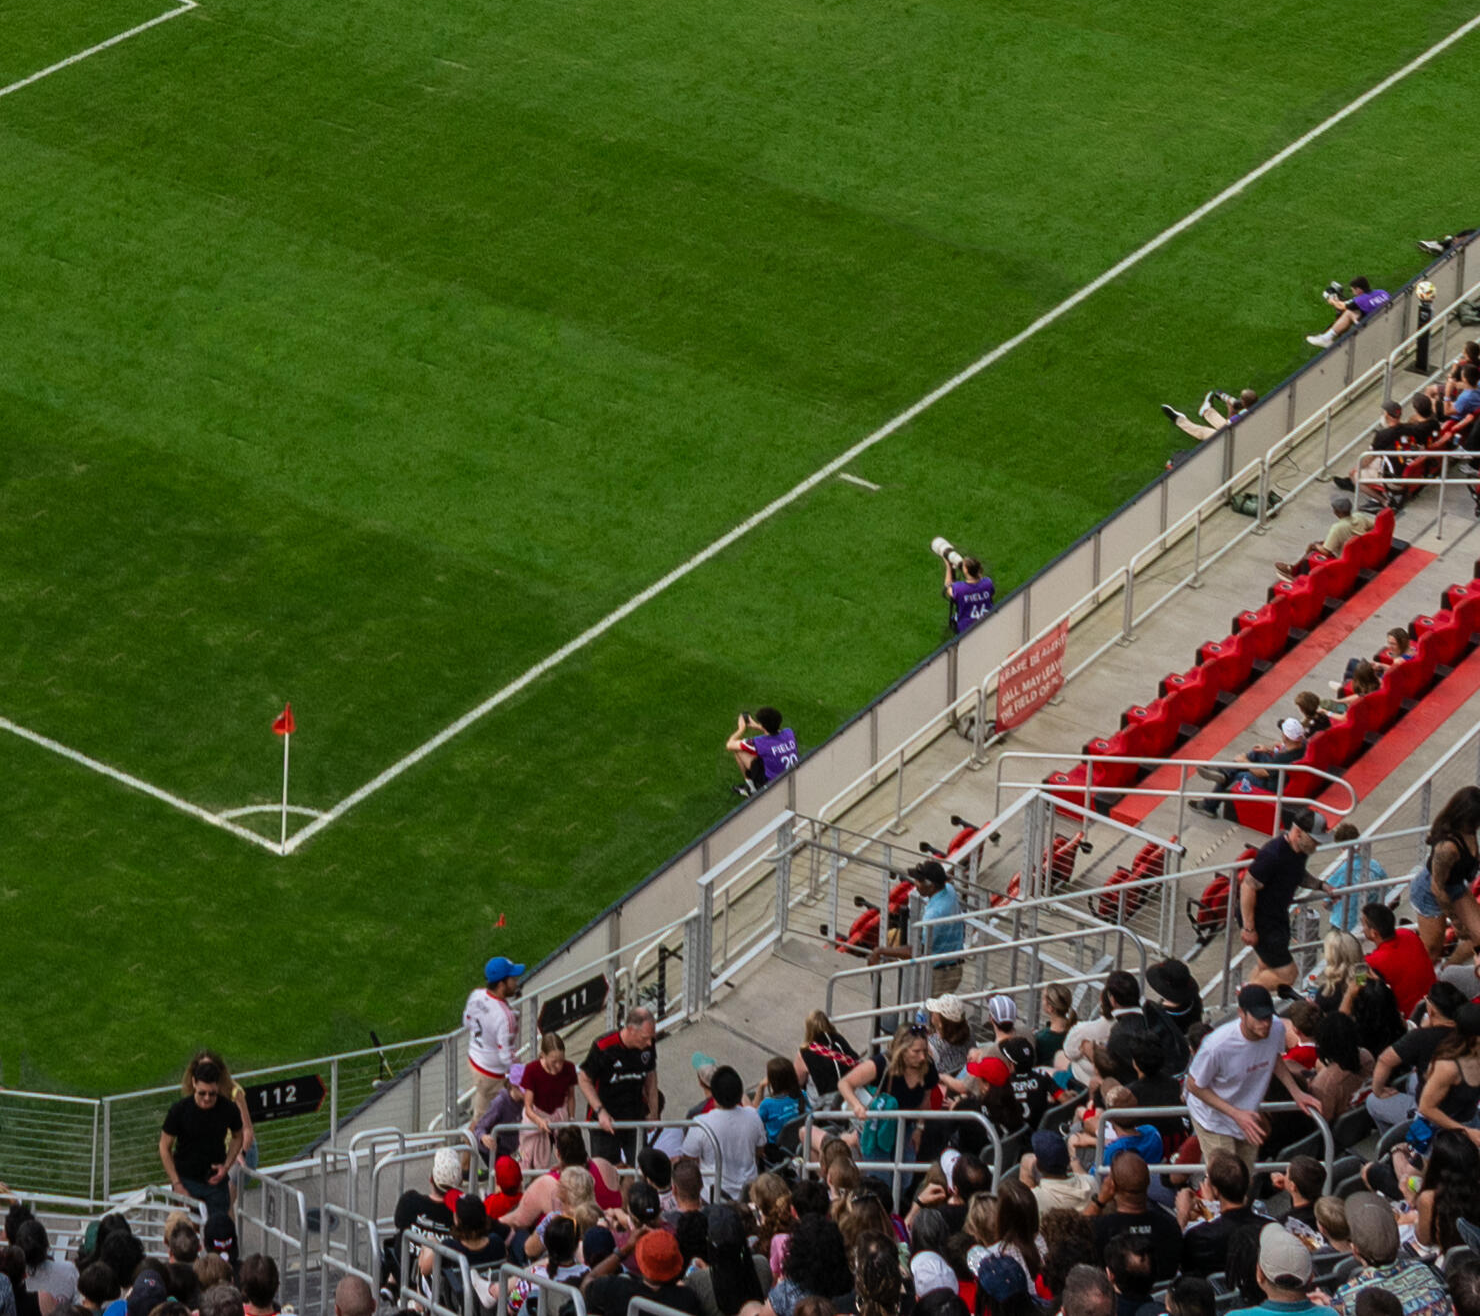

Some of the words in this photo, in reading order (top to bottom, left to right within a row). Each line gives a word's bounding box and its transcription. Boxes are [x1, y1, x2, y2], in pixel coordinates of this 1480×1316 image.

[964, 590, 991, 604] FIELD
[771, 741, 797, 757] FIELD
[561, 979, 587, 1015] 111
[259, 1084, 298, 1108] 112
